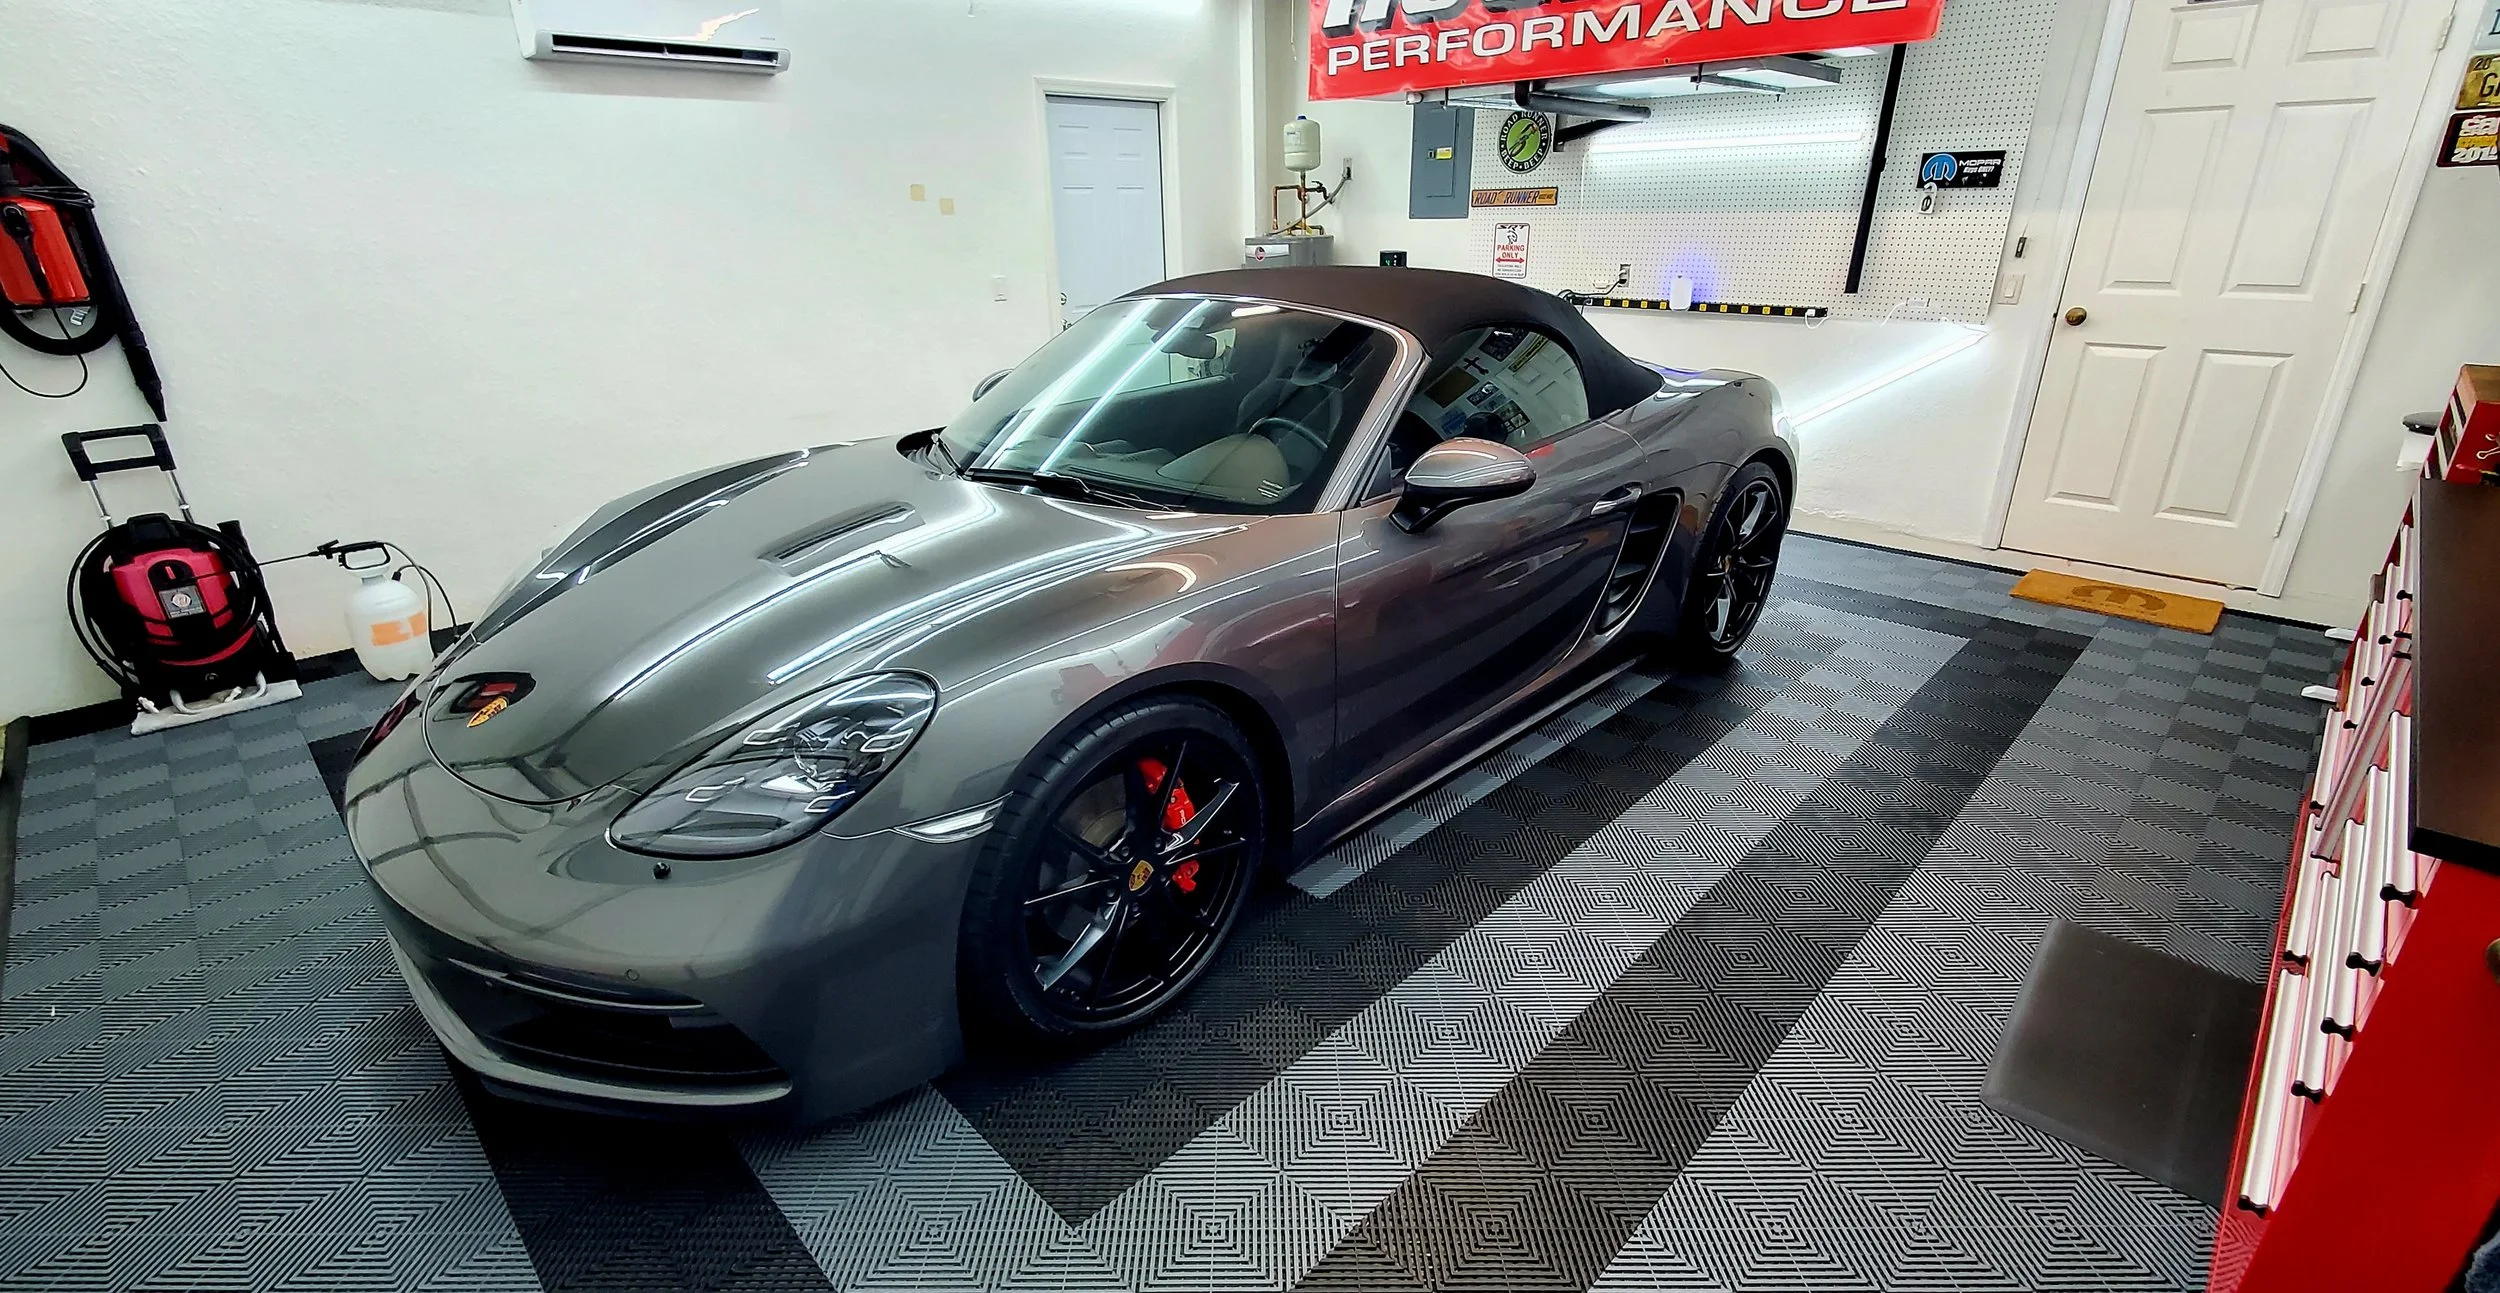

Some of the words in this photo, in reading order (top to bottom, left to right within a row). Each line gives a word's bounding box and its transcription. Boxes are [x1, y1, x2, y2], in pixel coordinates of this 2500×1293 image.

[1500, 113, 1518, 141] ROAD
[1521, 111, 1548, 140] RUNNER
[1474, 191, 1498, 205] ROAD
[1503, 190, 1540, 204] RUNNER
[1497, 244, 1525, 252] PARKING
